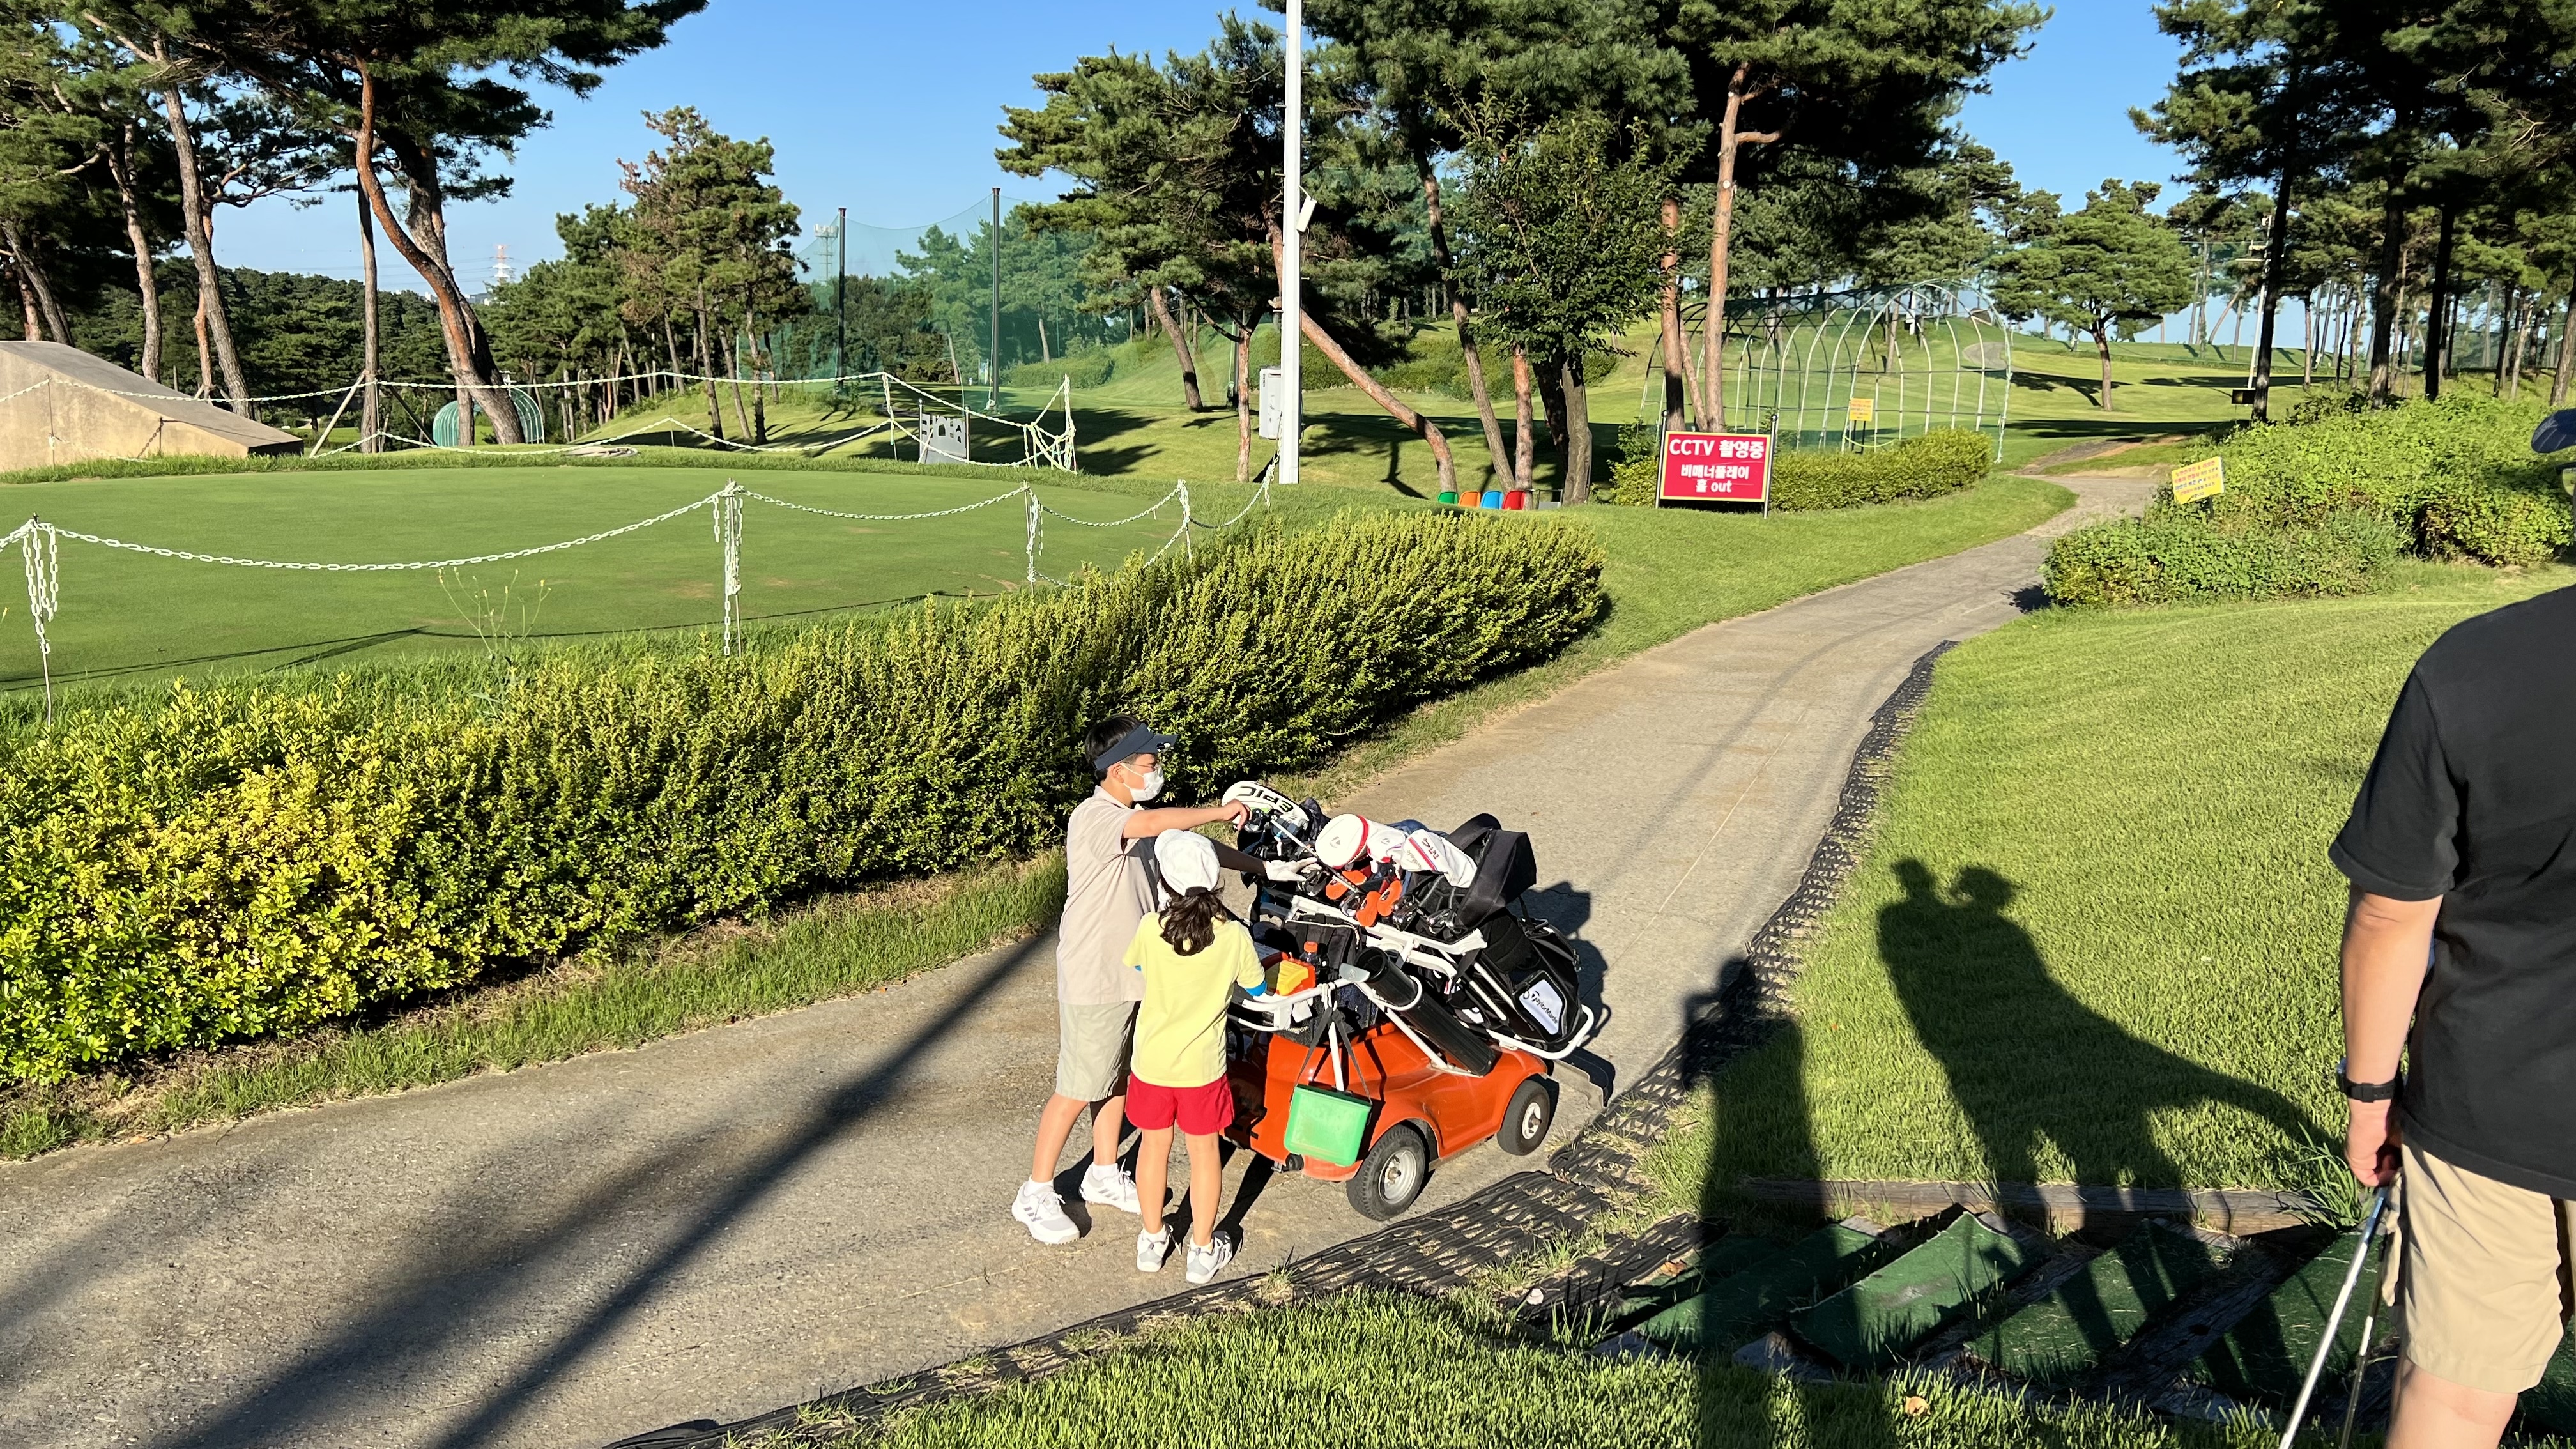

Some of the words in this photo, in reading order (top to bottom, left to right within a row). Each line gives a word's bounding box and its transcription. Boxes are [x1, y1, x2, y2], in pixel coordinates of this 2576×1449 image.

[1669, 438, 1715, 456] CCTV
[1719, 440, 1765, 459] 촬영중
[1680, 464, 1750, 479] 비매너플레이
[1710, 480, 1733, 493] out
[1236, 785, 1294, 813] EPIC
